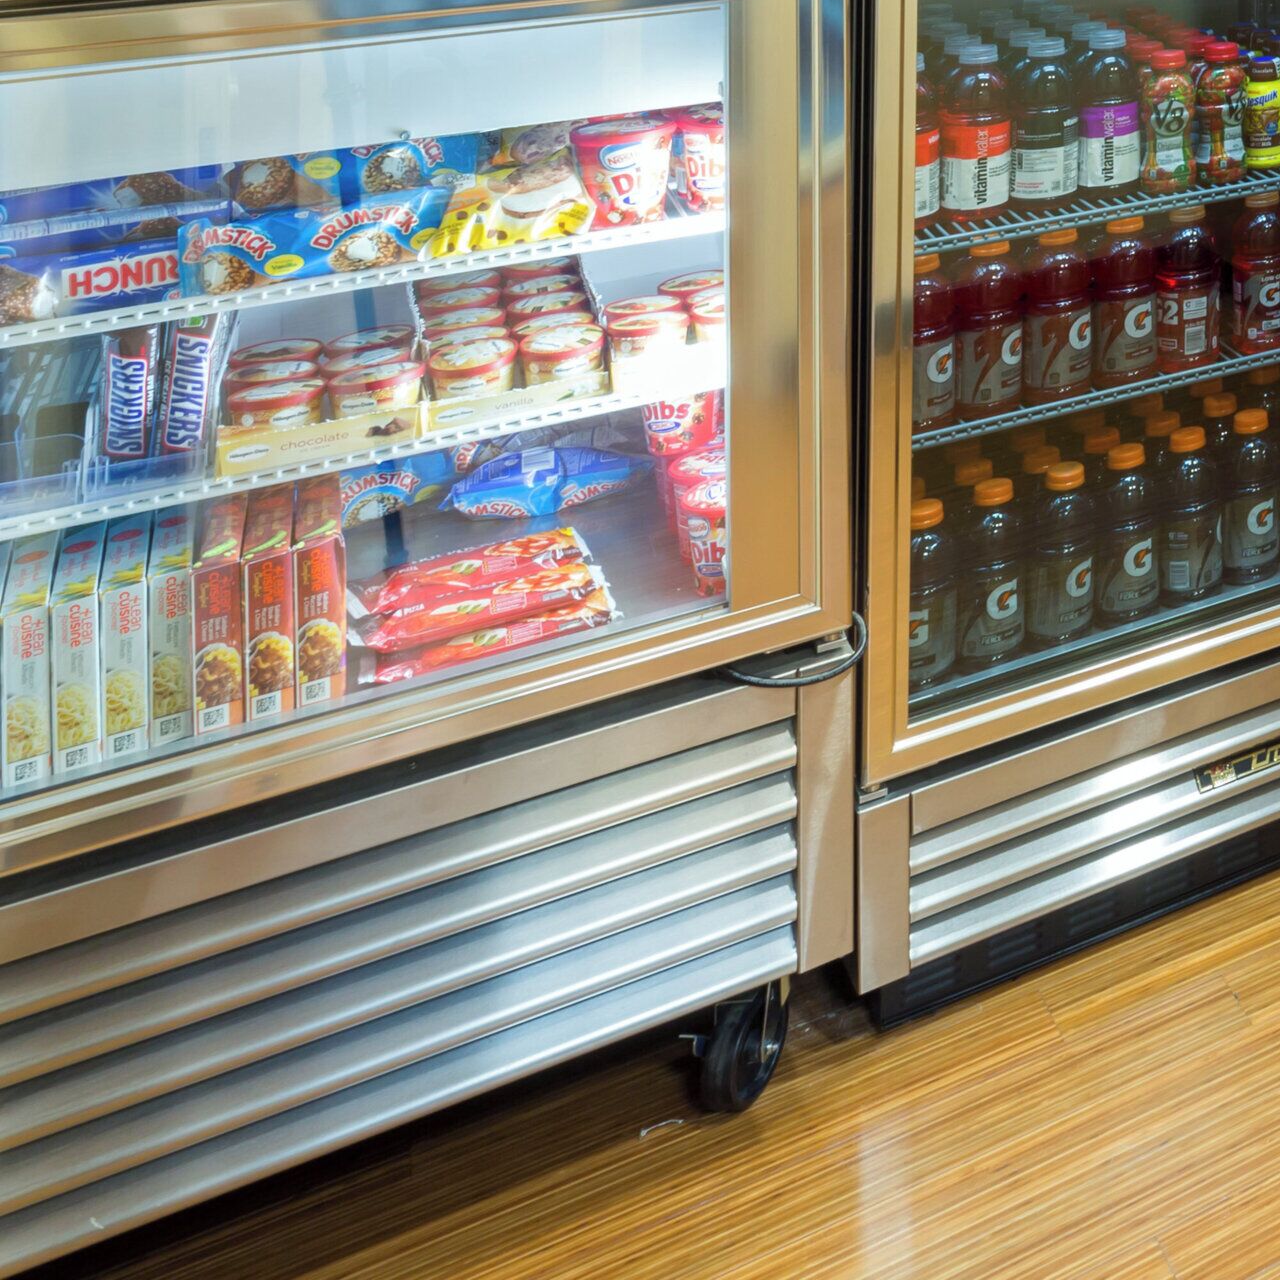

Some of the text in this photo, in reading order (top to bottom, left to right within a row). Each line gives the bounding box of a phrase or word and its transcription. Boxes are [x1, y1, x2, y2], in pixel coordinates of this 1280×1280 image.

[1123, 300, 1153, 339] G
[926, 342, 953, 384] G
[106, 357, 146, 454] SNICKERS
[164, 336, 209, 448] SNICKERS
[494, 395, 534, 410] vanilla
[280, 430, 349, 451] chocolate
[1246, 499, 1275, 535] G
[1065, 556, 1093, 598] G
[1123, 537, 1153, 577] G
[986, 578, 1018, 621] G
